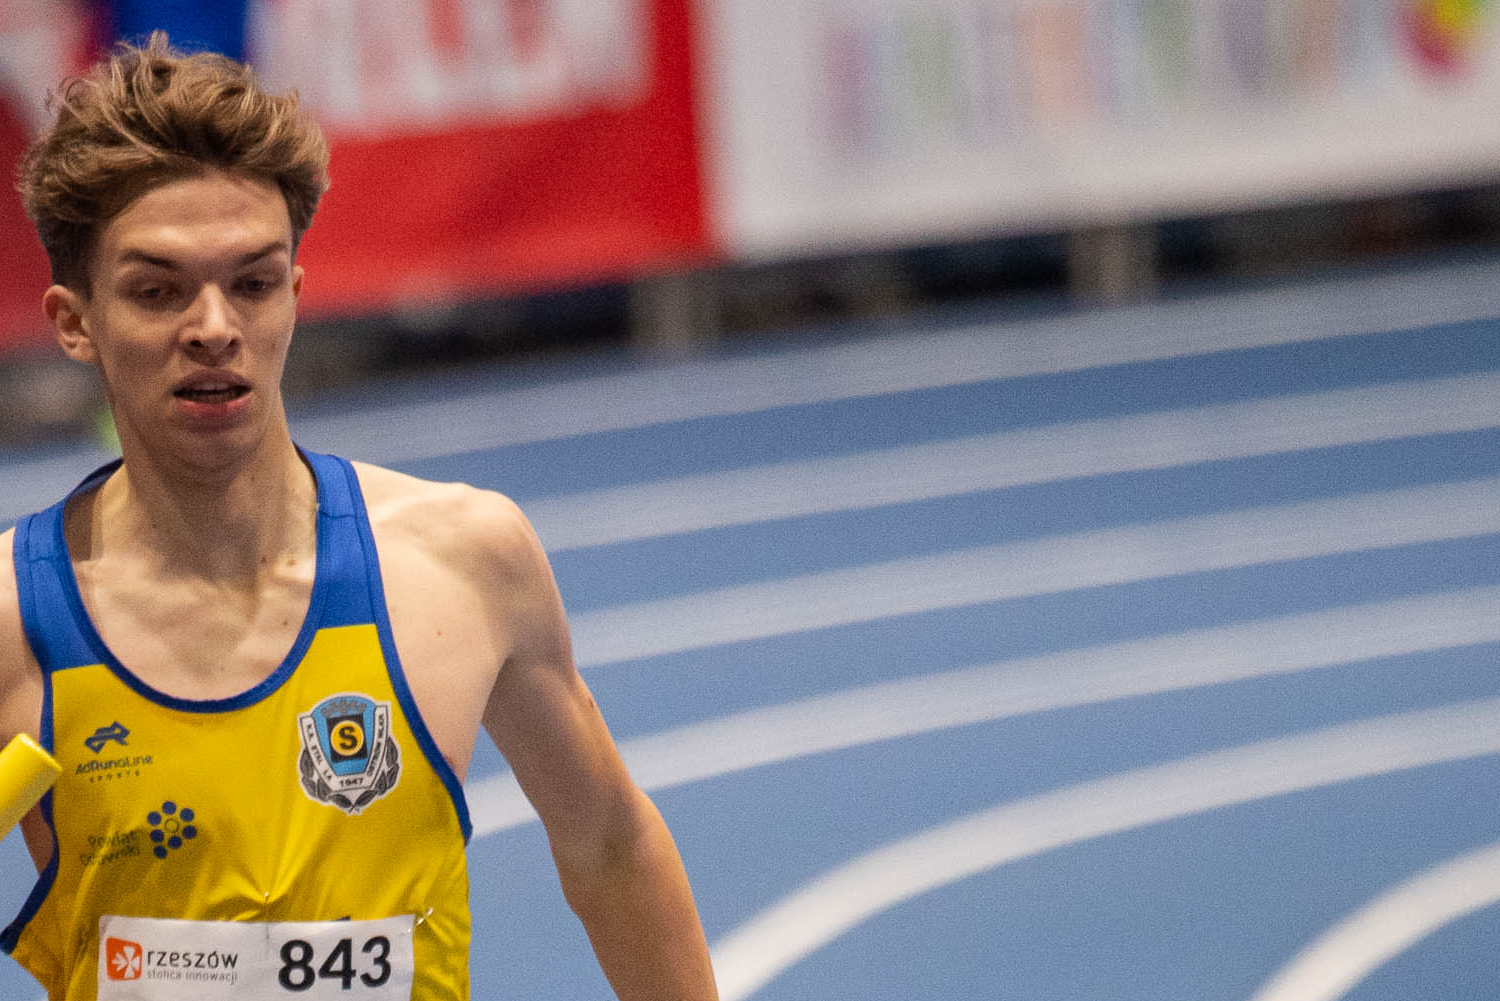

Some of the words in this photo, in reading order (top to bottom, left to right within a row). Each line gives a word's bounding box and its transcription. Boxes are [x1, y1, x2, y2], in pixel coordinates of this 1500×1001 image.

[338, 725, 359, 750] S
[147, 950, 239, 969] rzeszów
[278, 935, 392, 992] 843
[147, 968, 182, 980] stolica
[185, 970, 238, 985] innowacji
